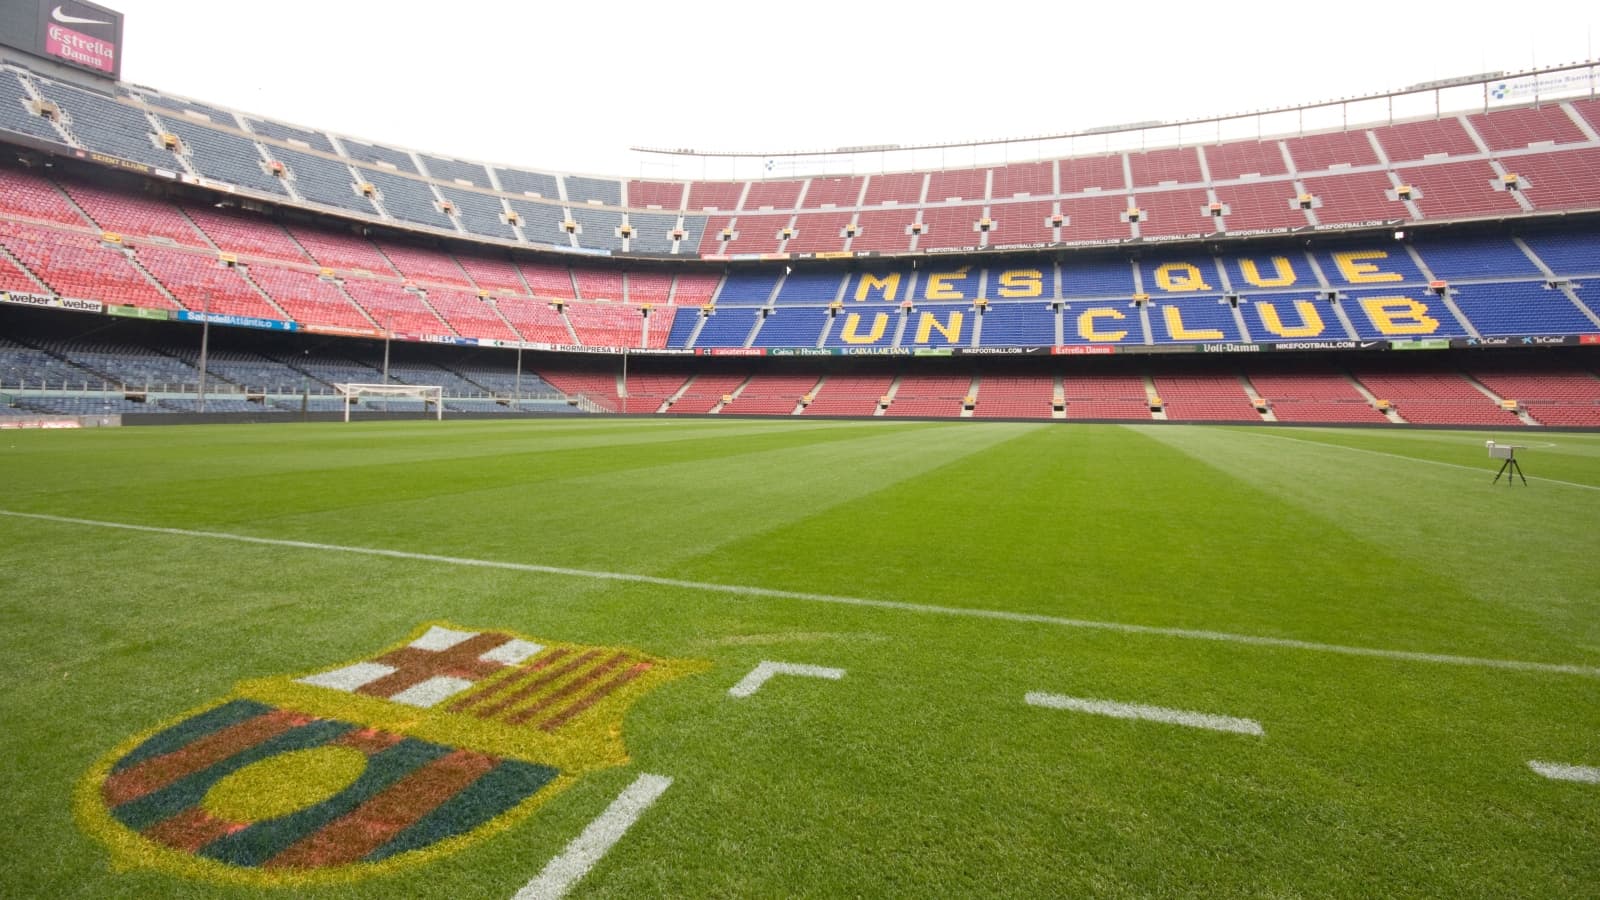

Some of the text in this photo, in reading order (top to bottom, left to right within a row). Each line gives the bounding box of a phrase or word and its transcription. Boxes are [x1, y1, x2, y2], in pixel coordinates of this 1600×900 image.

[49, 26, 113, 58] Estrella
[61, 44, 102, 66] Damm
[855, 250, 1403, 302] MÉS QUE
[8, 292, 50, 305] weber
[62, 299, 101, 311] weber
[840, 296, 1440, 345] UN CLUB
[560, 344, 612, 353] HORMIPRESA
[1275, 342, 1355, 350] NIKEFOOTBALL.COM
